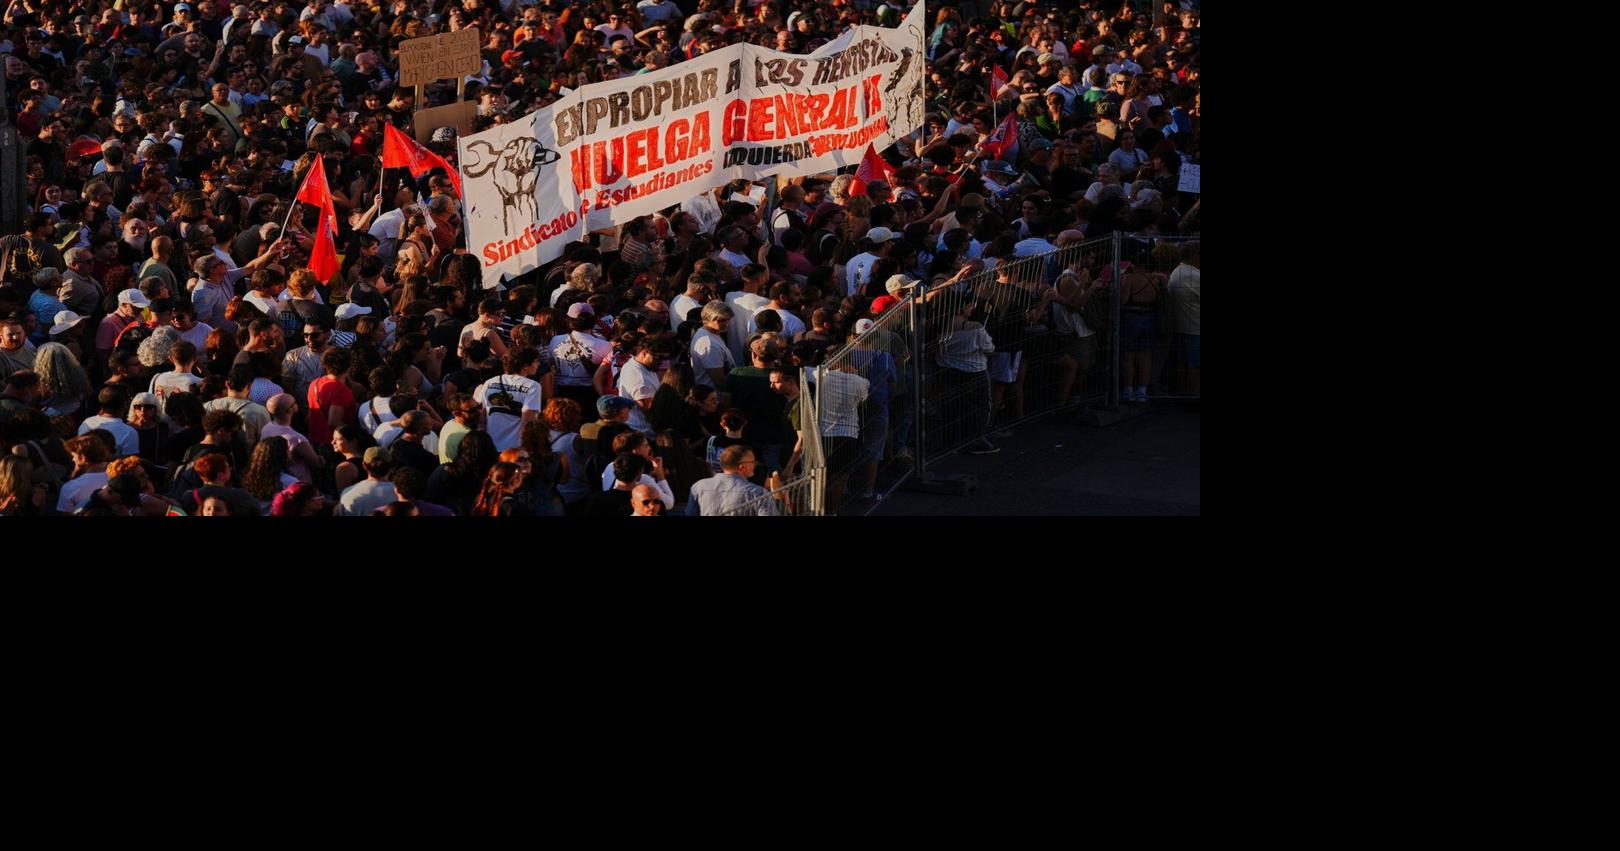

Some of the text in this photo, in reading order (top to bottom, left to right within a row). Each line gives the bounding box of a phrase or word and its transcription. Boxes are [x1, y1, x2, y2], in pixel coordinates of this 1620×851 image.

[554, 67, 718, 147] EXPROPIAR
[725, 58, 742, 95] A
[569, 111, 712, 195] HUELGA
[721, 85, 859, 147] GENERAL
[482, 210, 578, 268] Sindicato
[594, 158, 714, 211] Estudiantes
